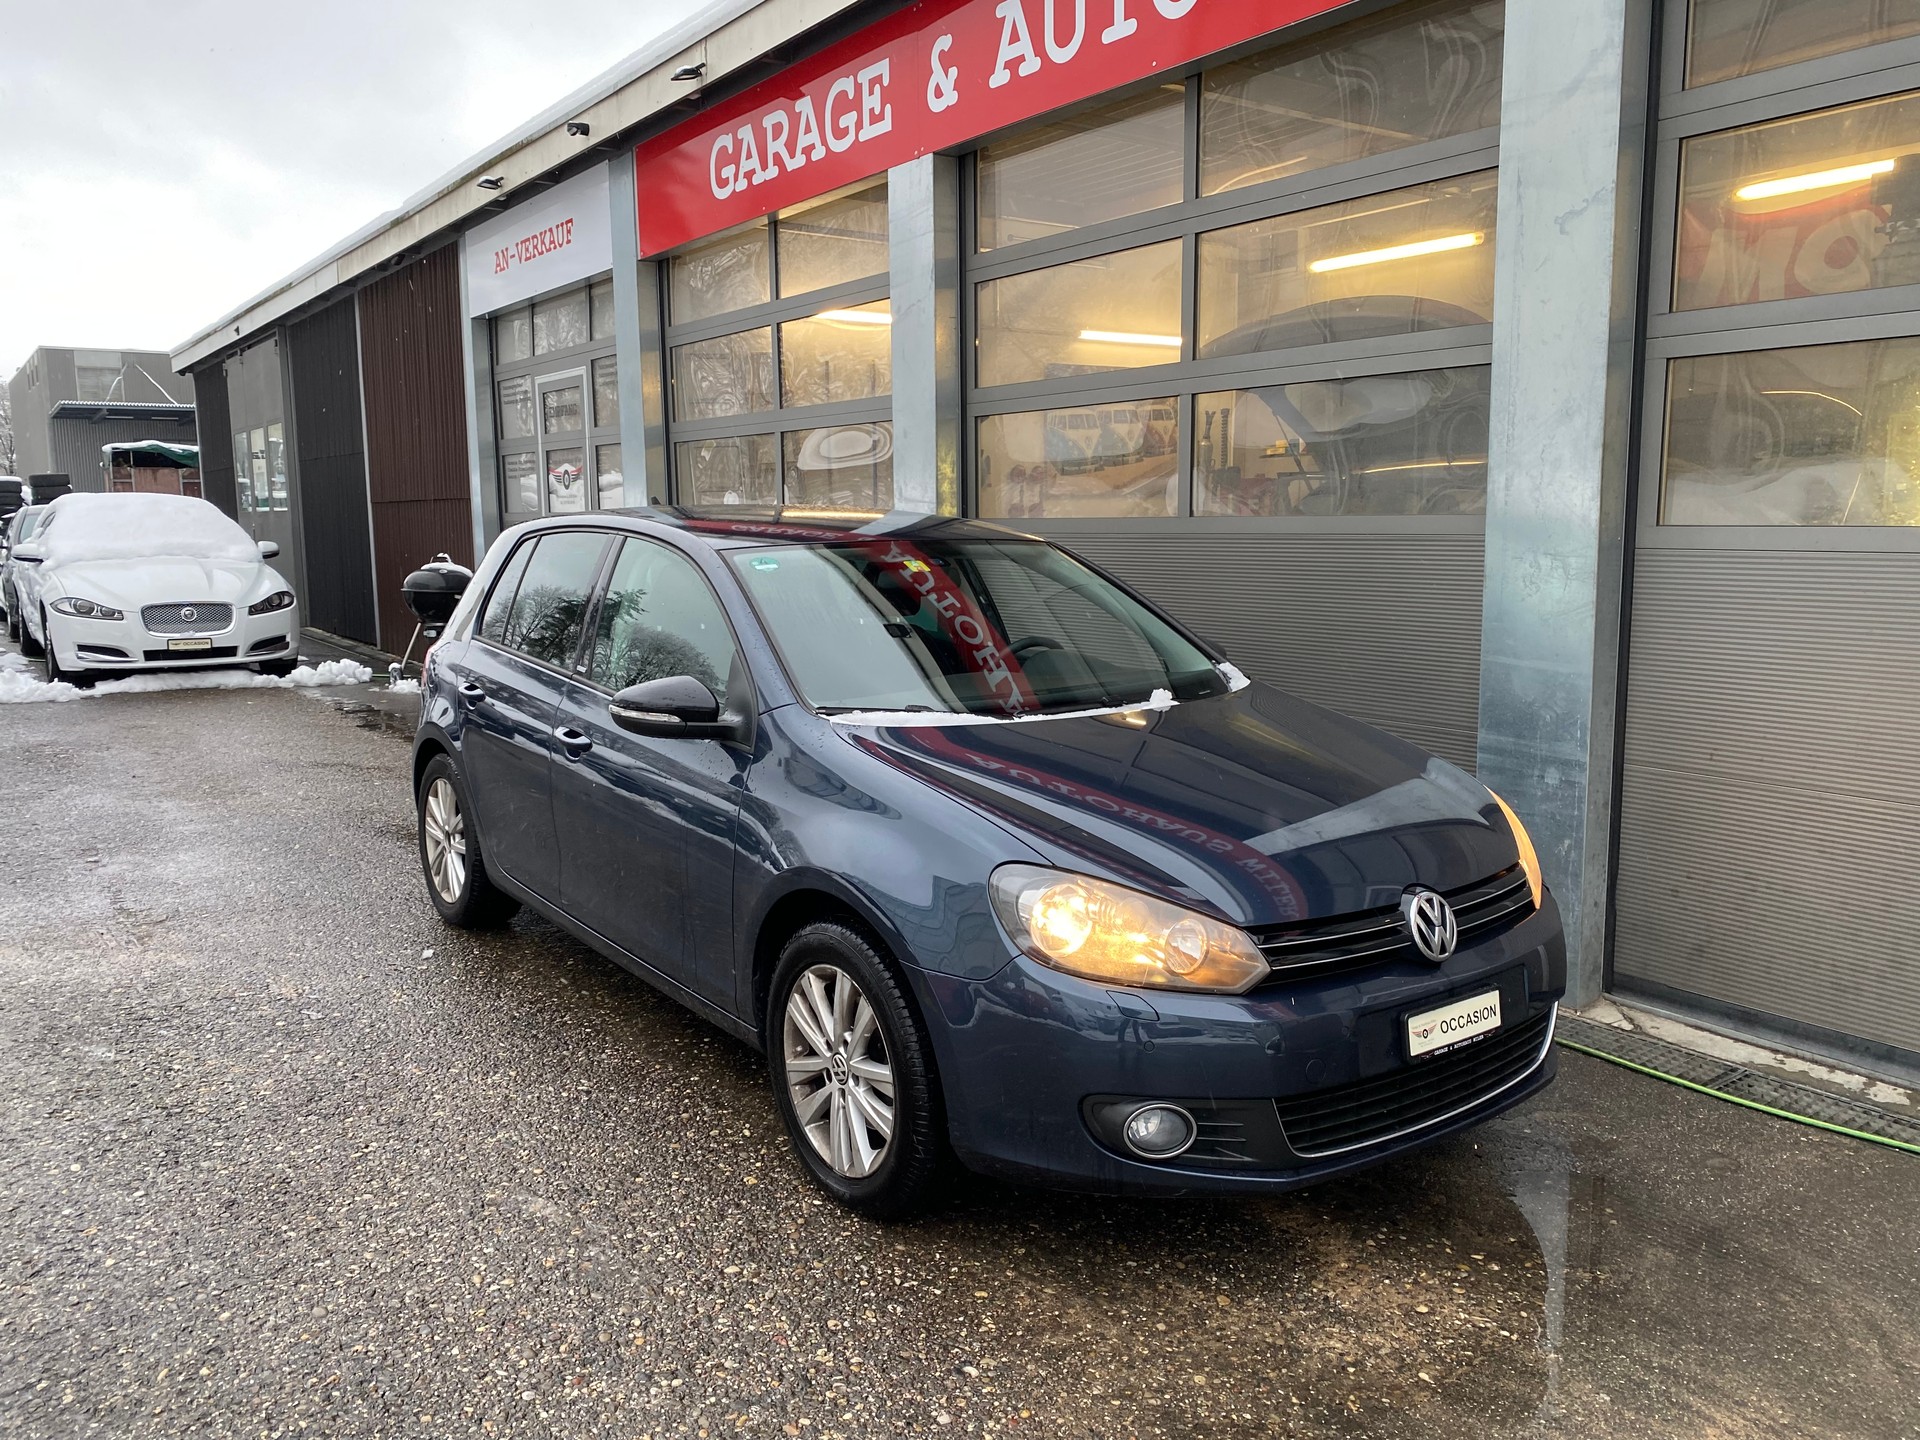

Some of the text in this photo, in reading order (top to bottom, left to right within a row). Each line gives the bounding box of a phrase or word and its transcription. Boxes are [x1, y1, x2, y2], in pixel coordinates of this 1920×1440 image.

[709, 0, 1198, 199] GARAGE & AU
[494, 217, 574, 274] AN-VERKAUF
[1440, 1004, 1497, 1034] OCCASION
